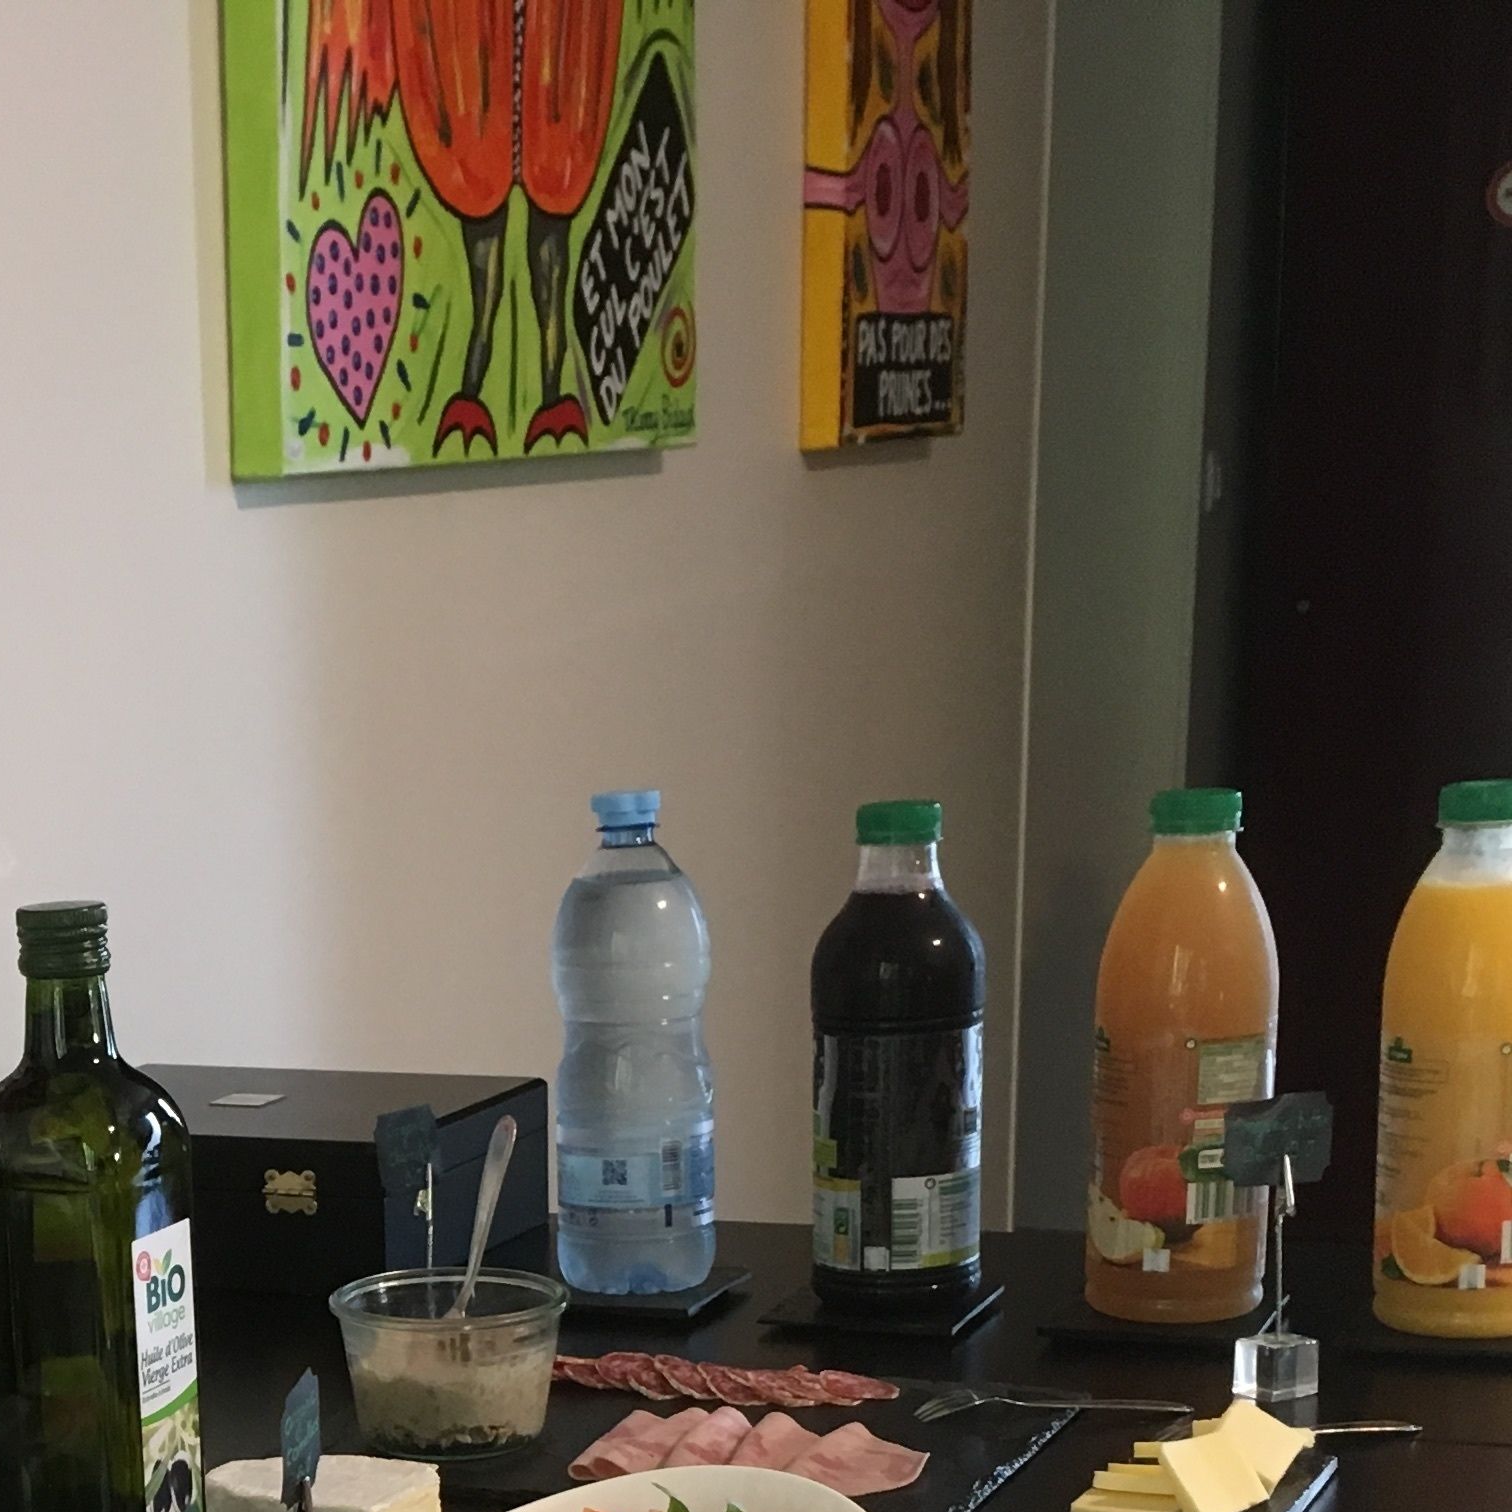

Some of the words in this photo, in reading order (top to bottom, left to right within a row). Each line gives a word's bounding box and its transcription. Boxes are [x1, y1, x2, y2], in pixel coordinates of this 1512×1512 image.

[581, 229, 606, 315] ET
[606, 120, 650, 249] MON
[599, 348, 626, 425] DU
[628, 151, 689, 348] POULET
[591, 284, 626, 376] CUL
[146, 1264, 185, 1313] BIO
